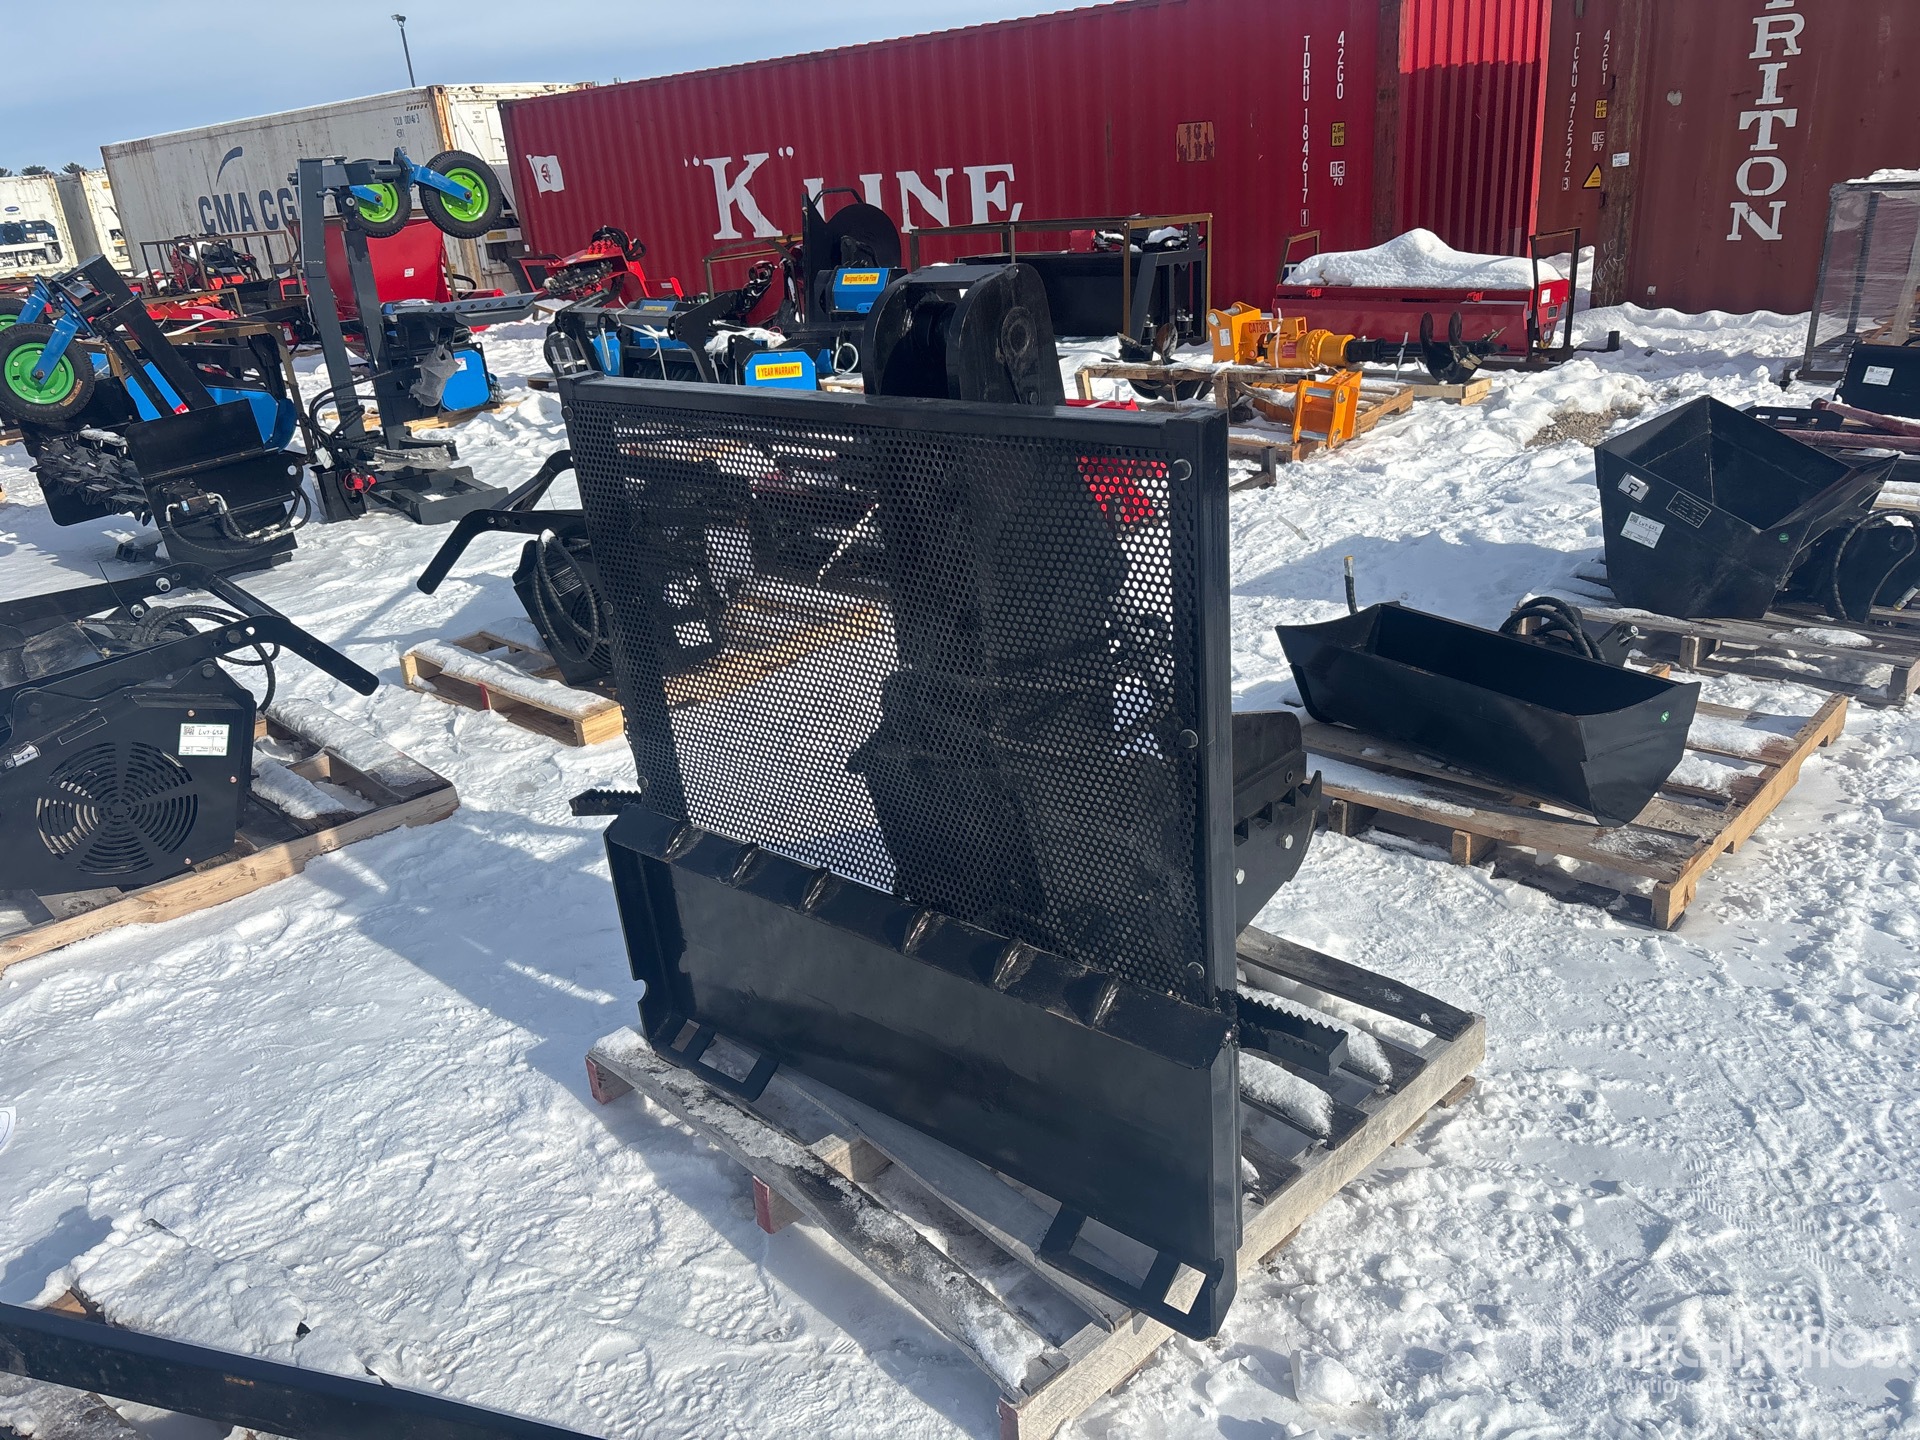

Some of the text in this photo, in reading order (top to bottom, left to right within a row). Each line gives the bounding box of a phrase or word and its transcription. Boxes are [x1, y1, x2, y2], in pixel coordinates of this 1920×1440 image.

[1302, 35, 1310, 101] TDRU
[1563, 32, 1581, 190] TCKU 472542 3
[1727, 0, 1806, 241] RITON
[1333, 177, 1344, 186] 70
[198, 187, 299, 233] CMA CG
[761, 367, 774, 377] YEAR
[775, 365, 800, 376] WARRANTY
